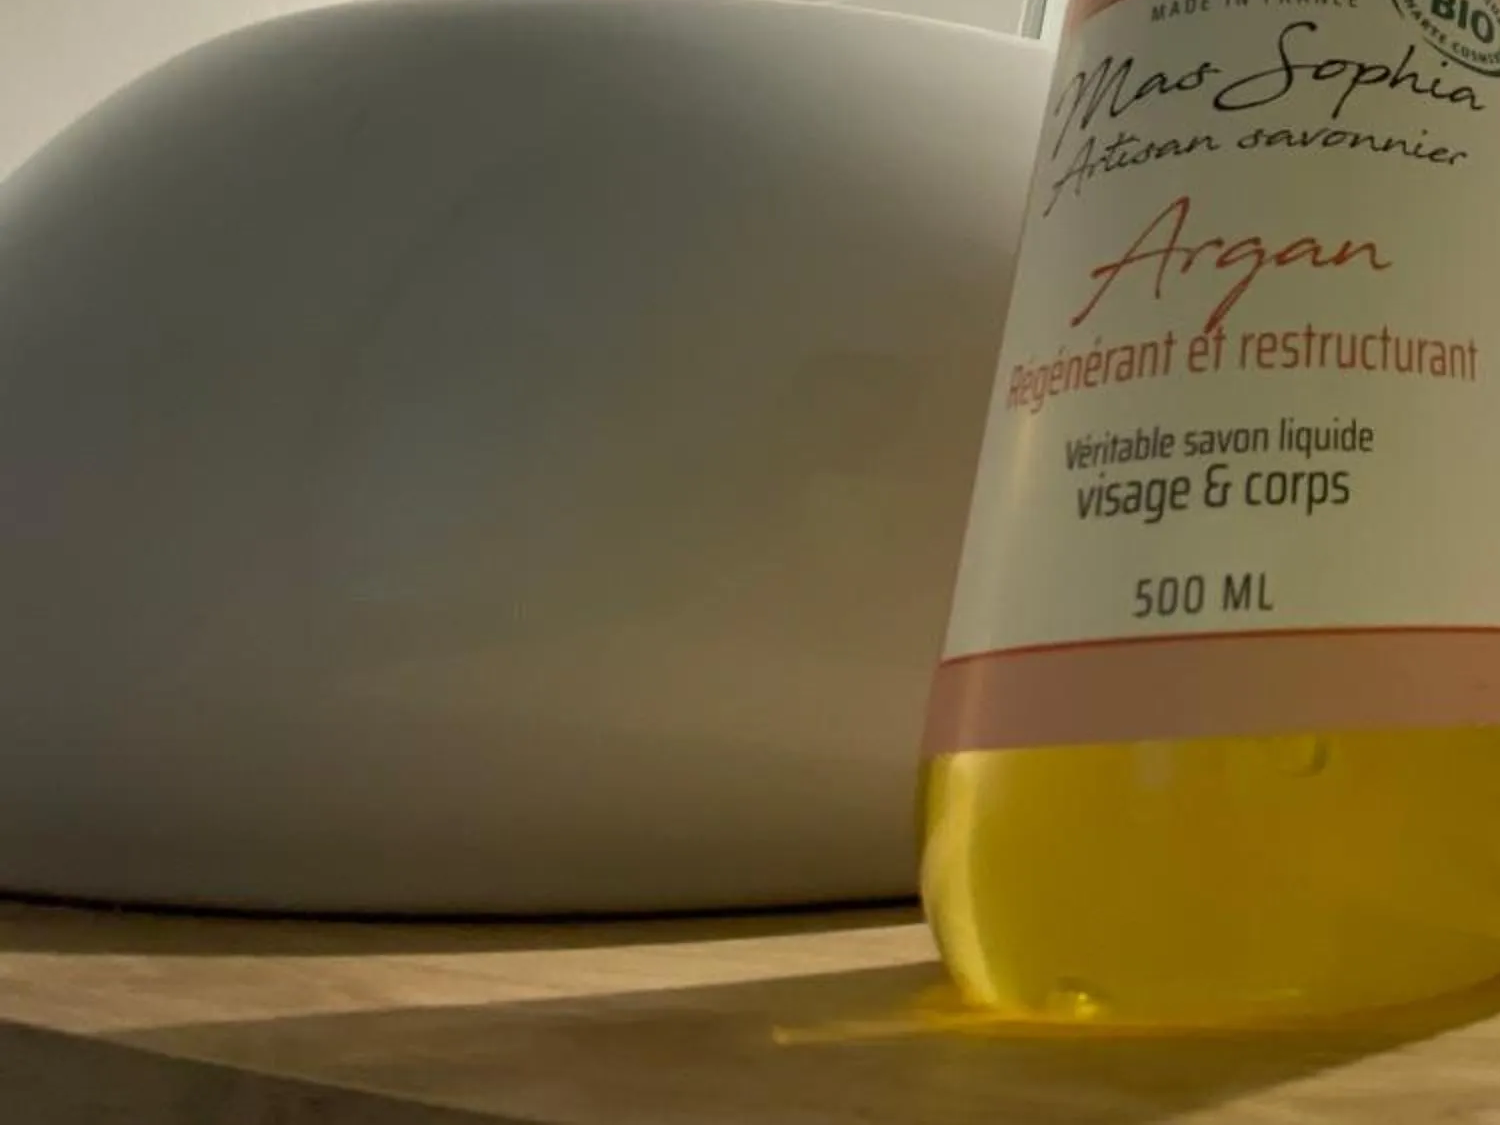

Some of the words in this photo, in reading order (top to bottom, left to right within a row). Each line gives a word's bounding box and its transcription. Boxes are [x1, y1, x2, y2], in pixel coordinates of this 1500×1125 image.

[1053, 56, 1223, 160] Mas
[1212, 21, 1486, 119] Sophia
[1043, 132, 1220, 218] Artisan
[1237, 128, 1469, 167] savonnier
[1070, 195, 1393, 334] Argan
[1006, 331, 1177, 414] Régénérant
[1187, 326, 1227, 373] et
[1240, 323, 1478, 381] restructurant
[1065, 425, 1175, 470] Véritable
[1184, 425, 1269, 456] savon
[1278, 417, 1374, 459] liquide
[1076, 473, 1191, 524] visage
[1203, 463, 1231, 509] &
[1245, 469, 1351, 515] corps
[1133, 574, 1204, 618] 500
[1221, 572, 1274, 612] ML
